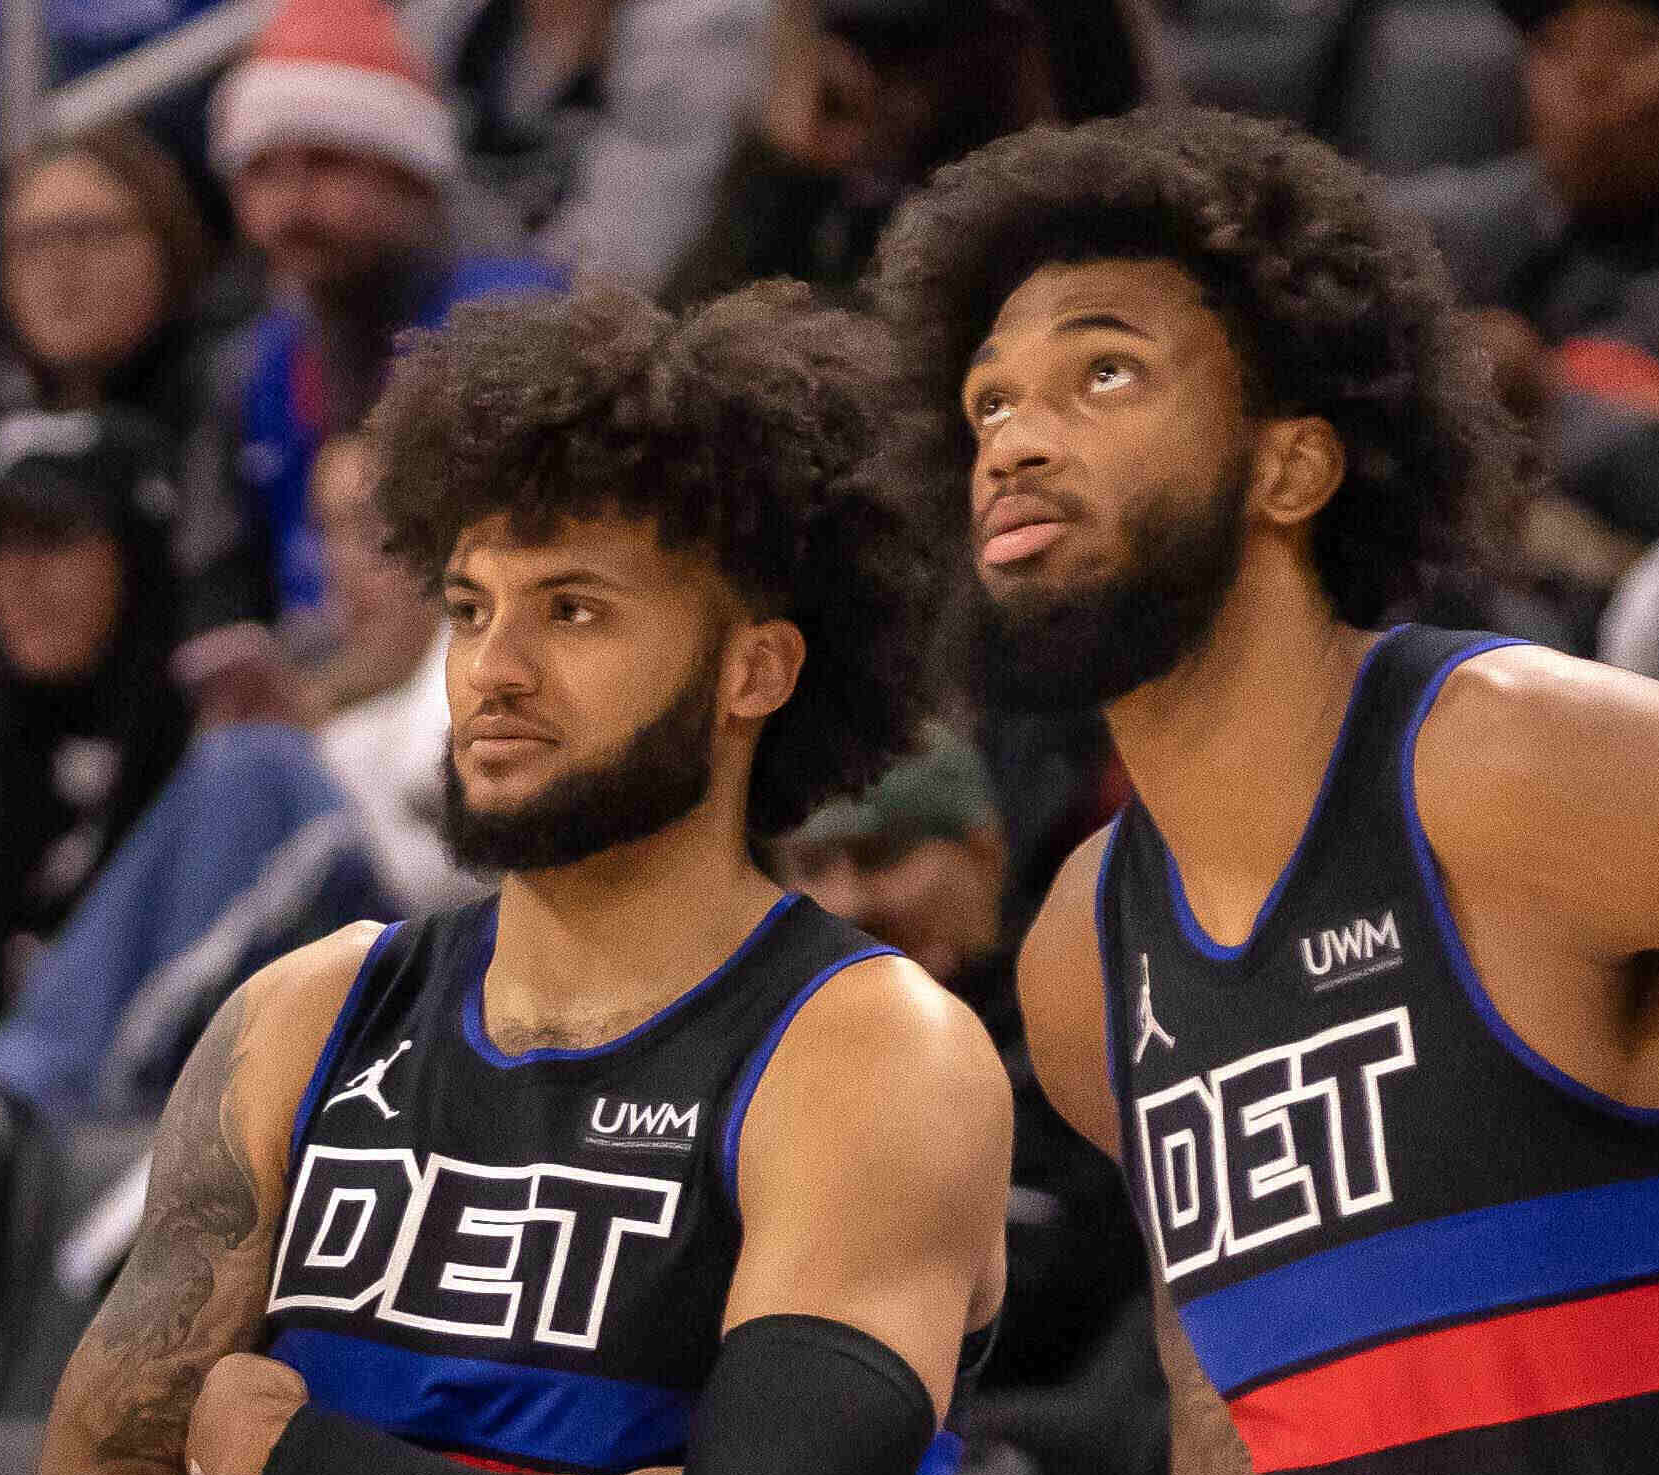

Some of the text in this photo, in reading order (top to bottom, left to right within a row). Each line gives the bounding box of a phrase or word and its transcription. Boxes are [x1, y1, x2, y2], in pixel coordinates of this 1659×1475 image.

[1299, 907, 1401, 976] UWM
[591, 1096, 701, 1138] UWM
[1135, 1005, 1418, 1283] DET
[265, 1144, 682, 1349] DET
